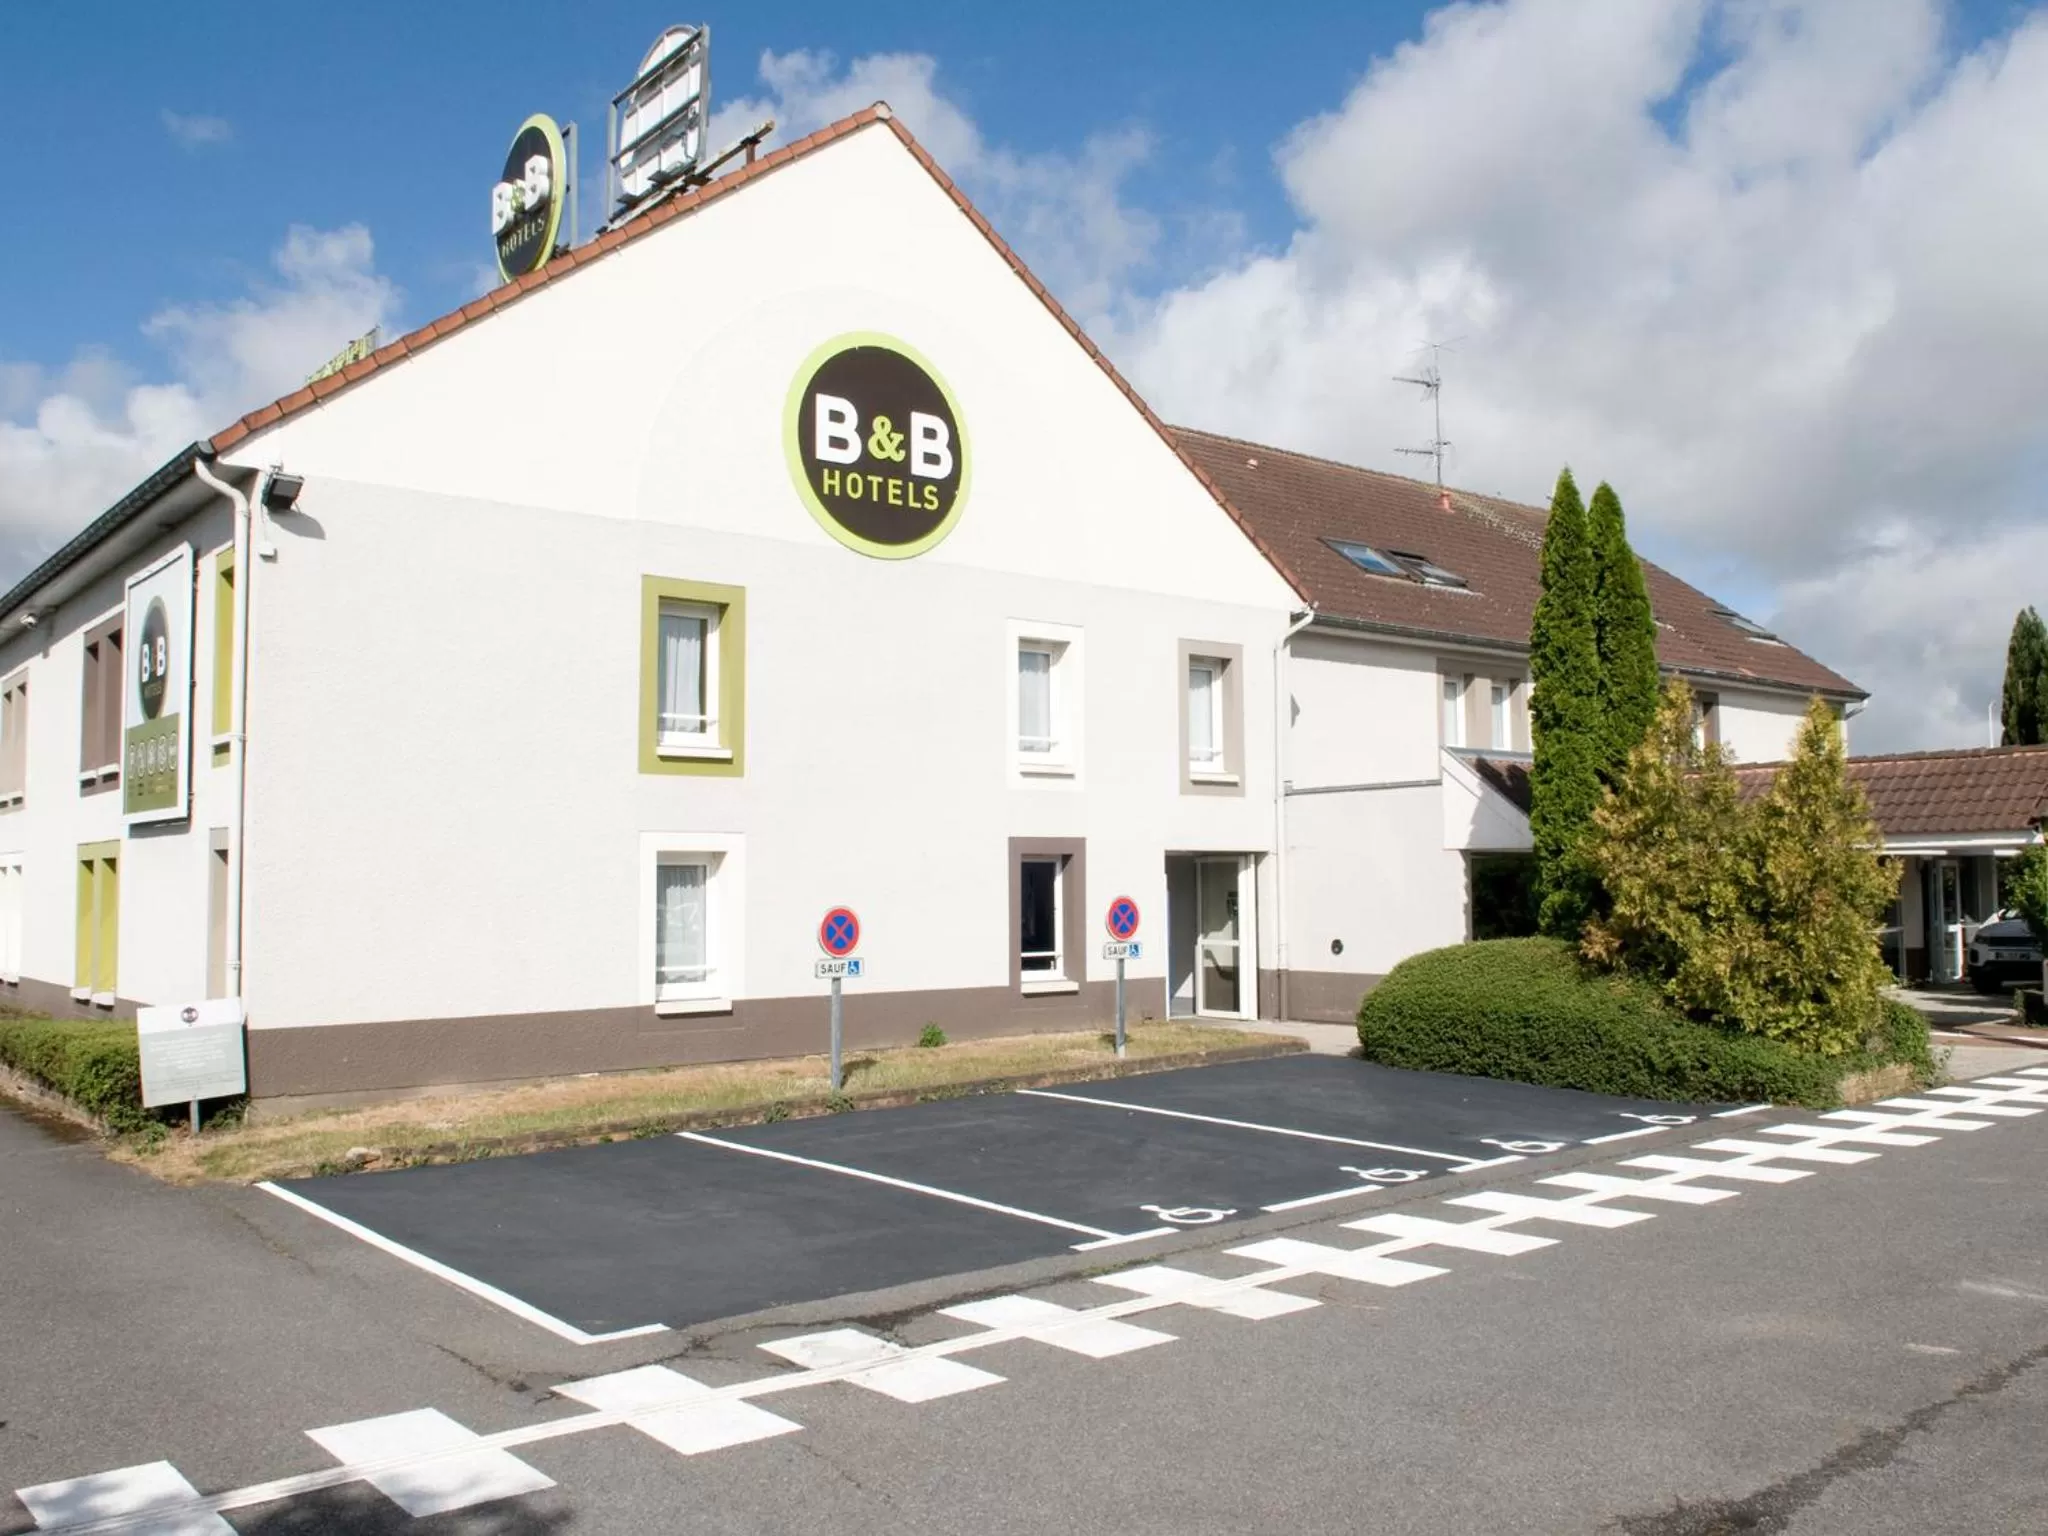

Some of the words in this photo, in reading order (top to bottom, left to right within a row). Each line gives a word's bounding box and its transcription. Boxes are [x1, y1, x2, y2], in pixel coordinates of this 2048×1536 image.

[492, 154, 550, 235] B&B
[501, 217, 545, 257] HOTELS
[815, 393, 953, 480] B&B
[823, 468, 939, 510] HOTELS
[820, 963, 847, 975] SAUF
[1107, 945, 1128, 956] SAUF
